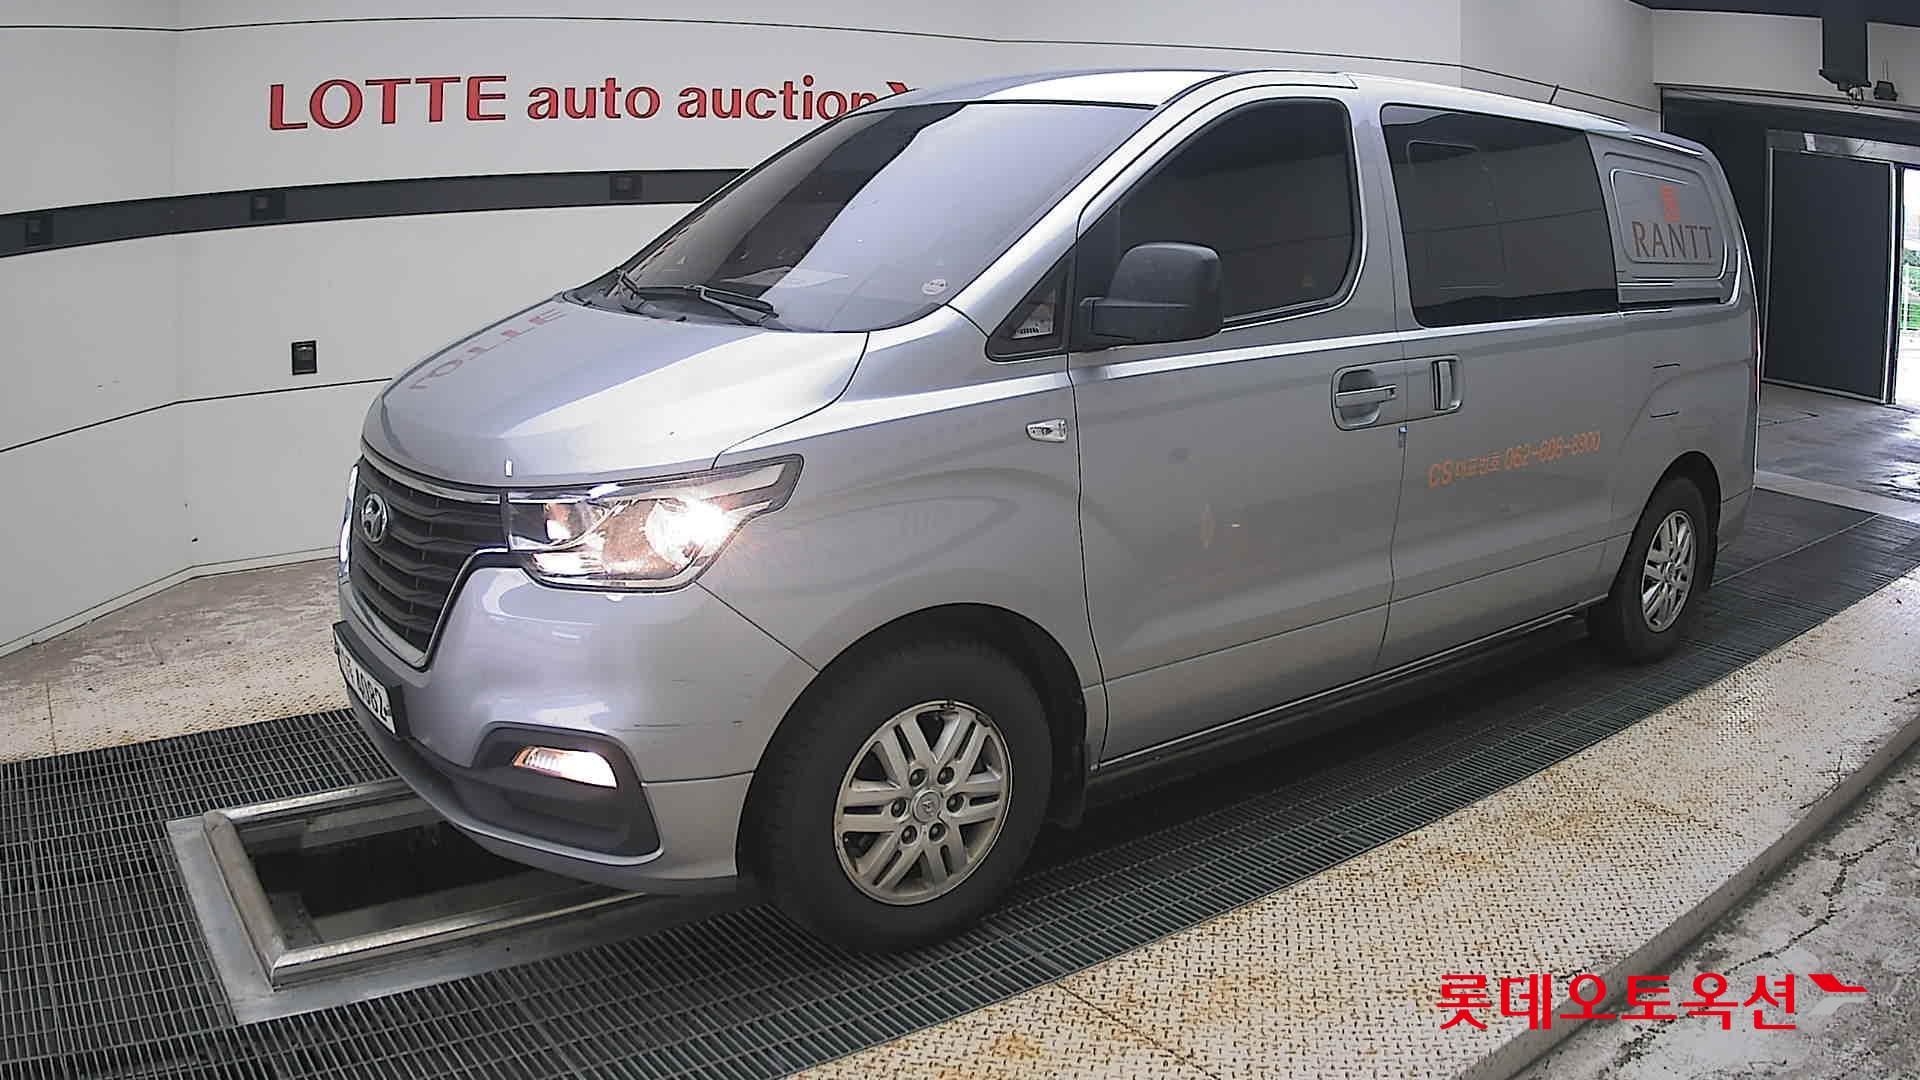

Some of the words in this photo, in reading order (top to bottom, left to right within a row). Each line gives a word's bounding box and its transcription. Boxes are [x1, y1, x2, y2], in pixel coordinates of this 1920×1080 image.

[270, 75, 507, 130] LOTTE
[527, 78, 661, 121] auto
[1631, 221, 1713, 260] RANTT
